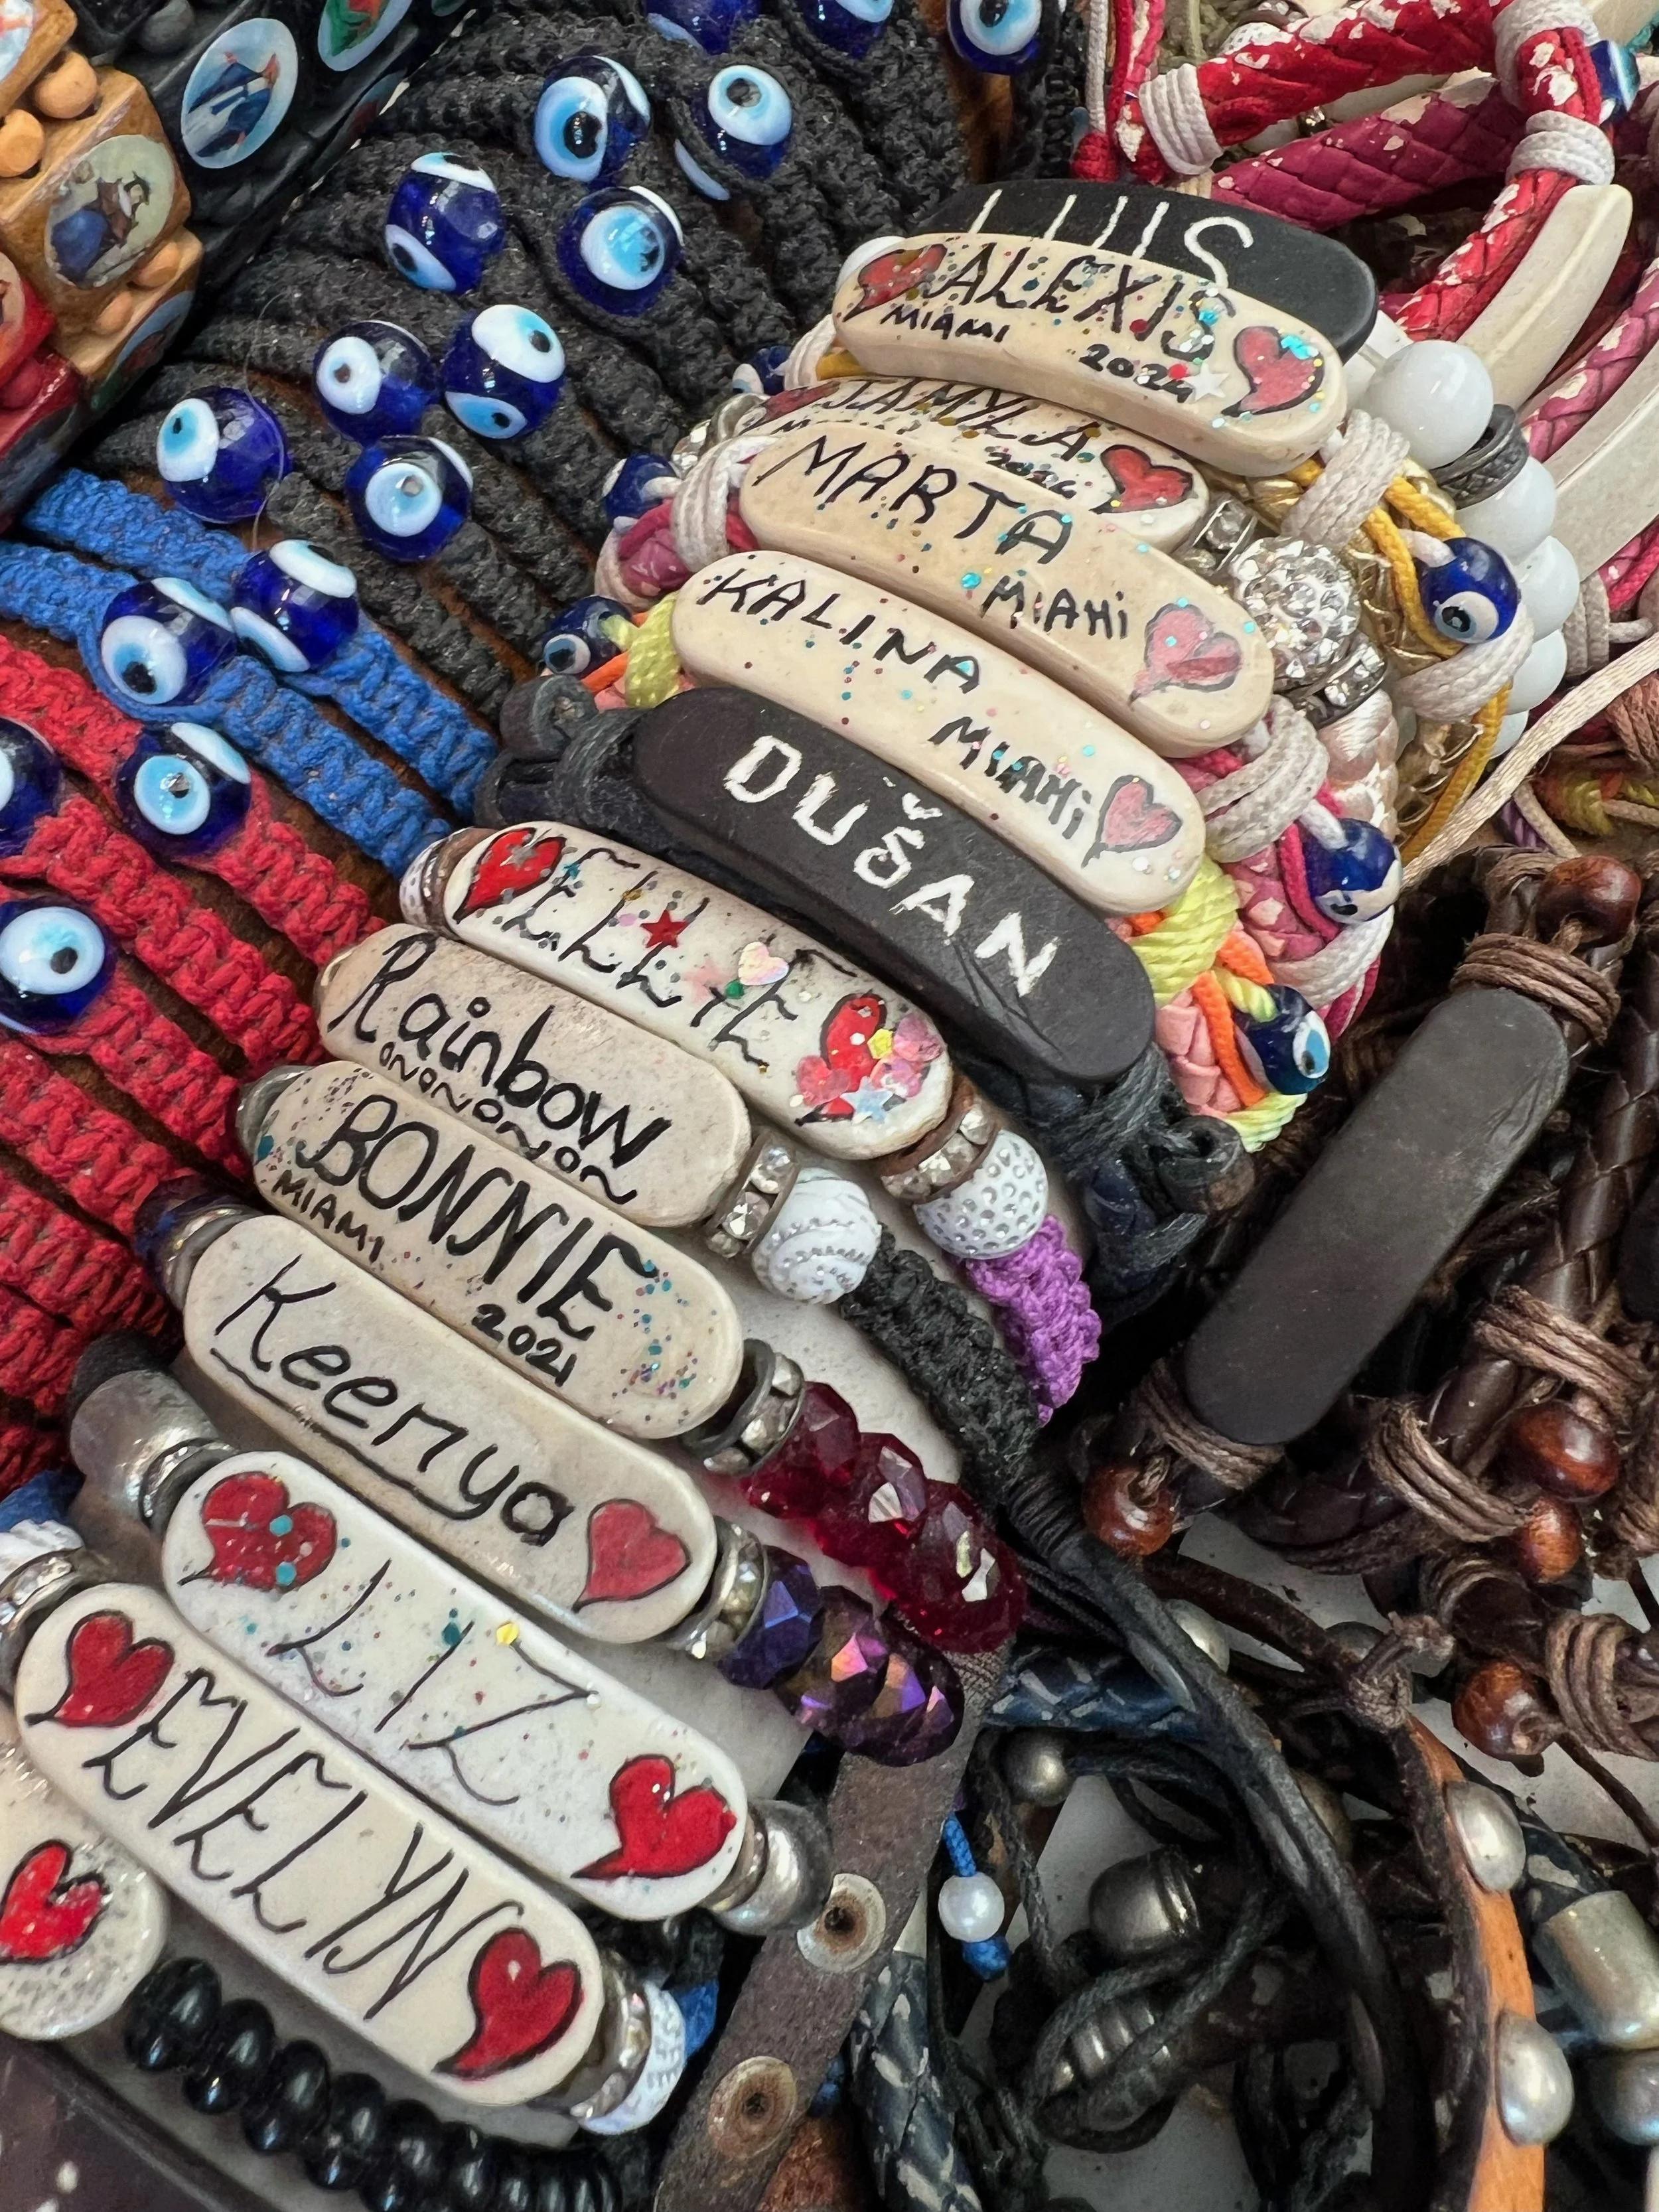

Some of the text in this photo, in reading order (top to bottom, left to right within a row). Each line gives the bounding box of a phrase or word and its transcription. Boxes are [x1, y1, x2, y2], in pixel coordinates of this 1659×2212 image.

[880, 305, 1010, 343] MIAMI
[924, 243, 1236, 360] ALEXIS
[753, 435, 1073, 564] MARTA
[697, 569, 979, 694] KALINA
[328, 933, 672, 1169] Rainbow
[272, 1170, 386, 1262] MIAMI
[295, 1093, 660, 1341] BONNIE
[472, 1304, 577, 1387] 2021
[83, 1668, 523, 2020] EVELYN
